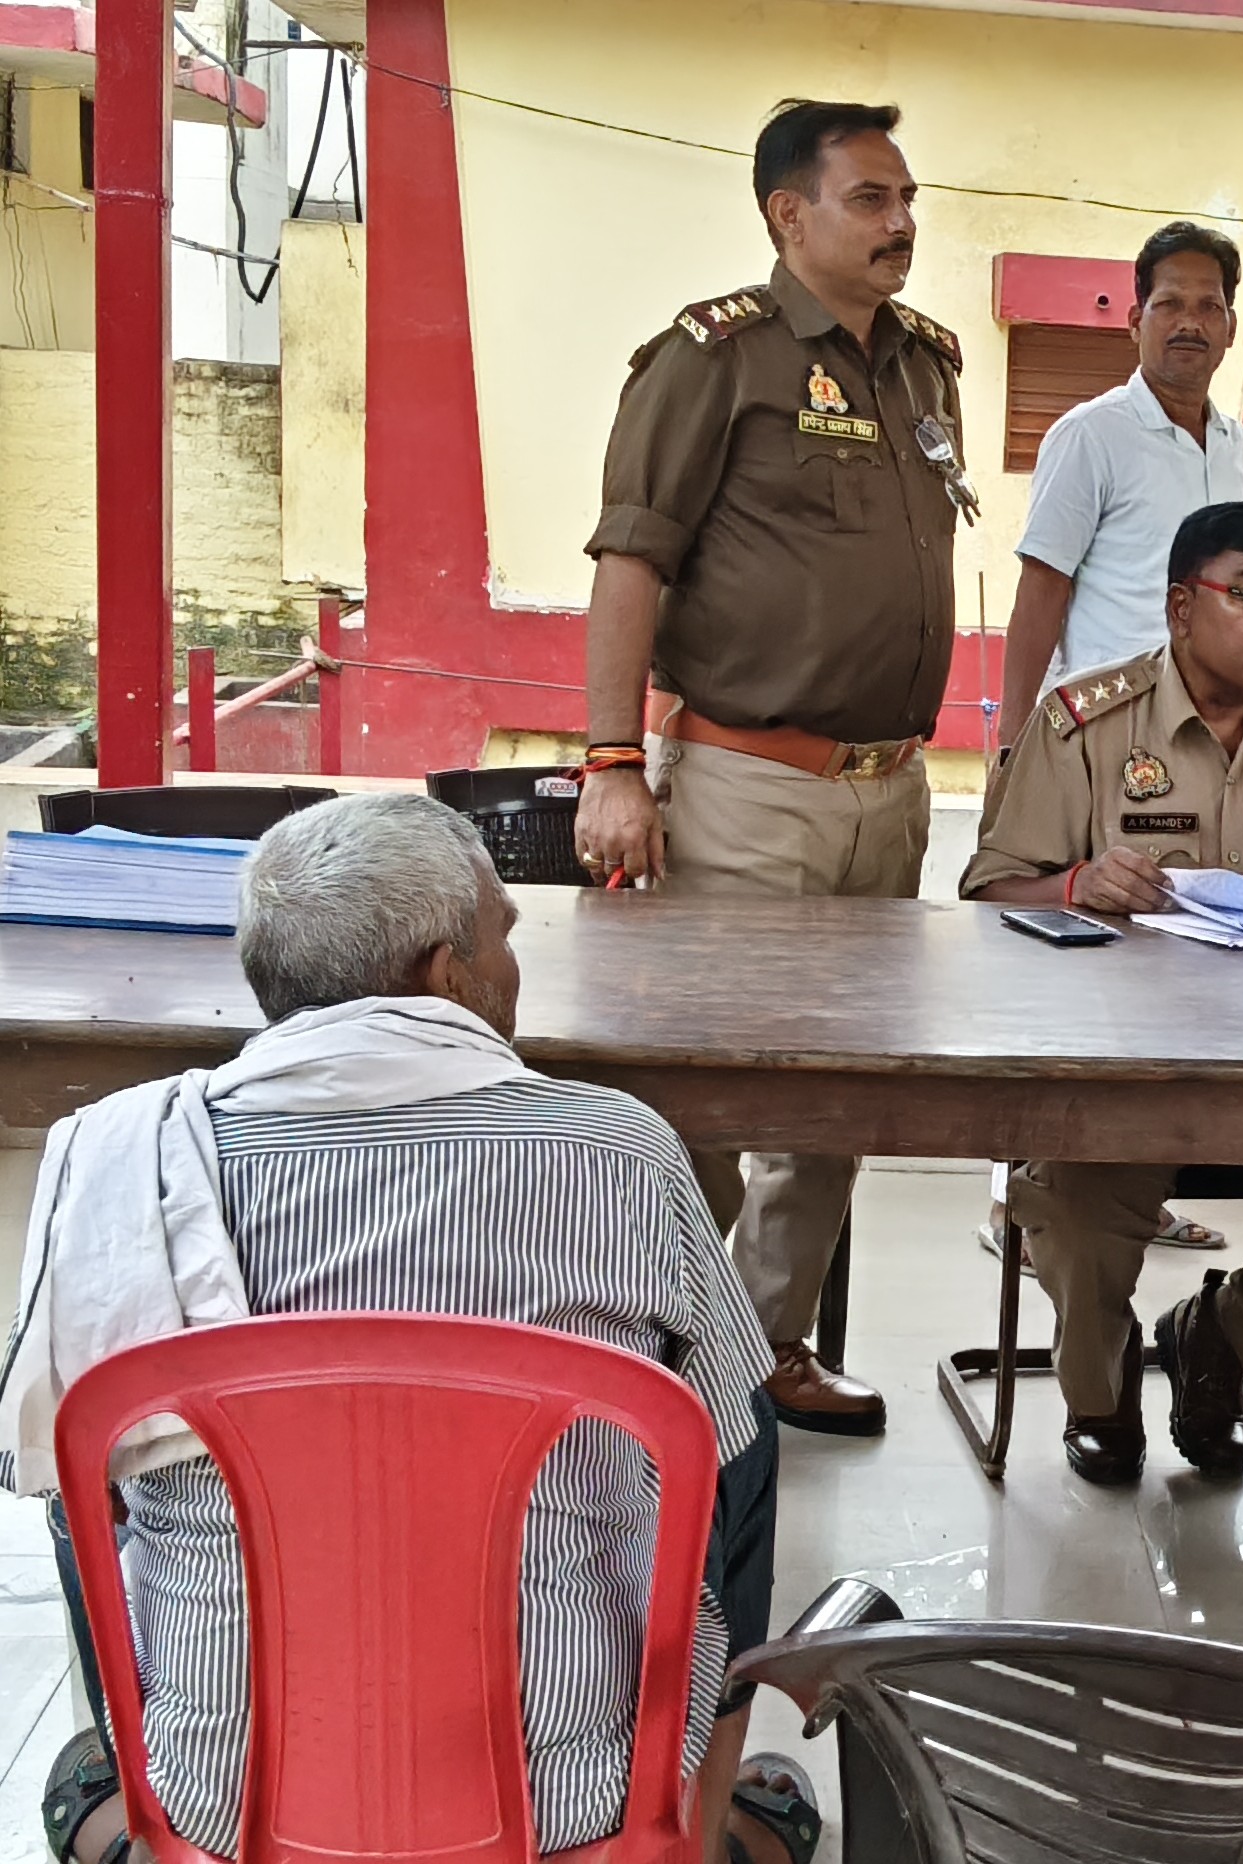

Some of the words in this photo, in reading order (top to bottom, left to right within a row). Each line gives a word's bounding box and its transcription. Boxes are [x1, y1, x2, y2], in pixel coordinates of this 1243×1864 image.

[1128, 818, 1137, 827] A
[1139, 817, 1147, 827] K
[1149, 817, 1192, 828] PANDEY
